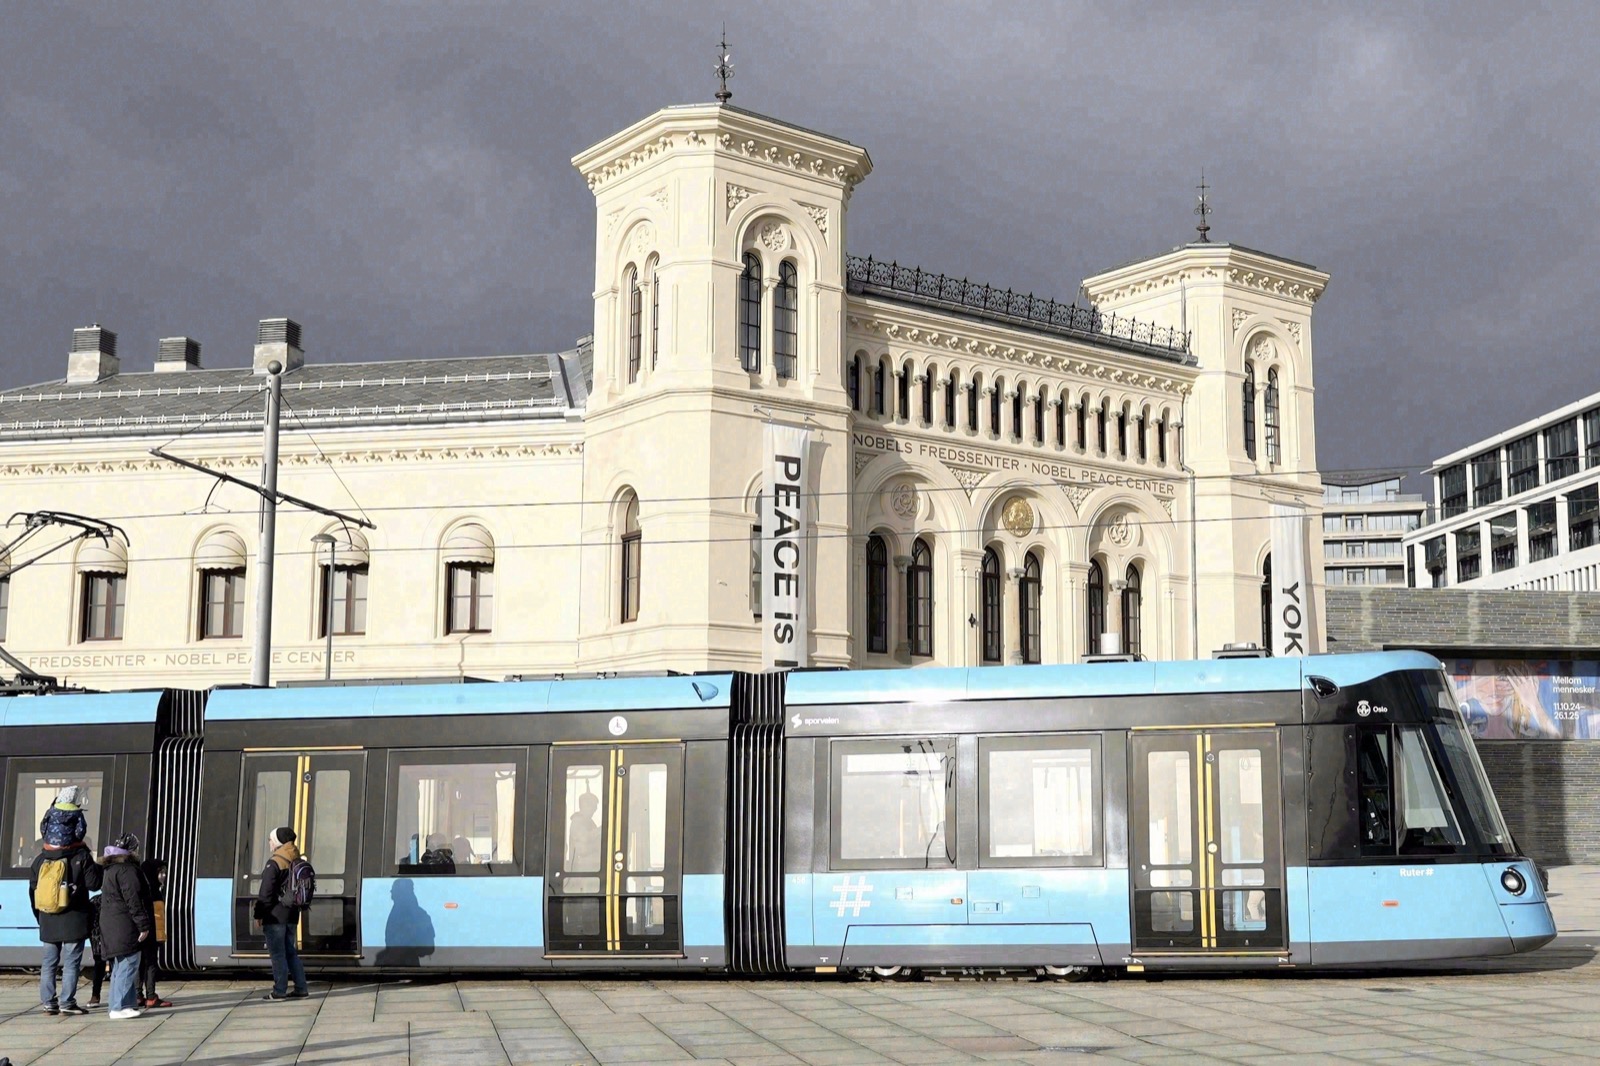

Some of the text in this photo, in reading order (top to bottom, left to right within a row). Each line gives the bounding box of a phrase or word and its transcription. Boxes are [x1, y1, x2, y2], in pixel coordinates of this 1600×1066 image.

[853, 433, 1175, 495] NOBELS FREDSSENTER NOBEL PEACE CENTER
[773, 454, 801, 597] PEACE
[29, 654, 146, 668] FREDSSENTER
[165, 653, 221, 666] NOBEL
[226, 651, 282, 665] PEE
[1552, 676, 1595, 693] Mellom mennesker
[1372, 705, 1388, 713] Oslo
[1554, 712, 1580, 720] 26.1.25
